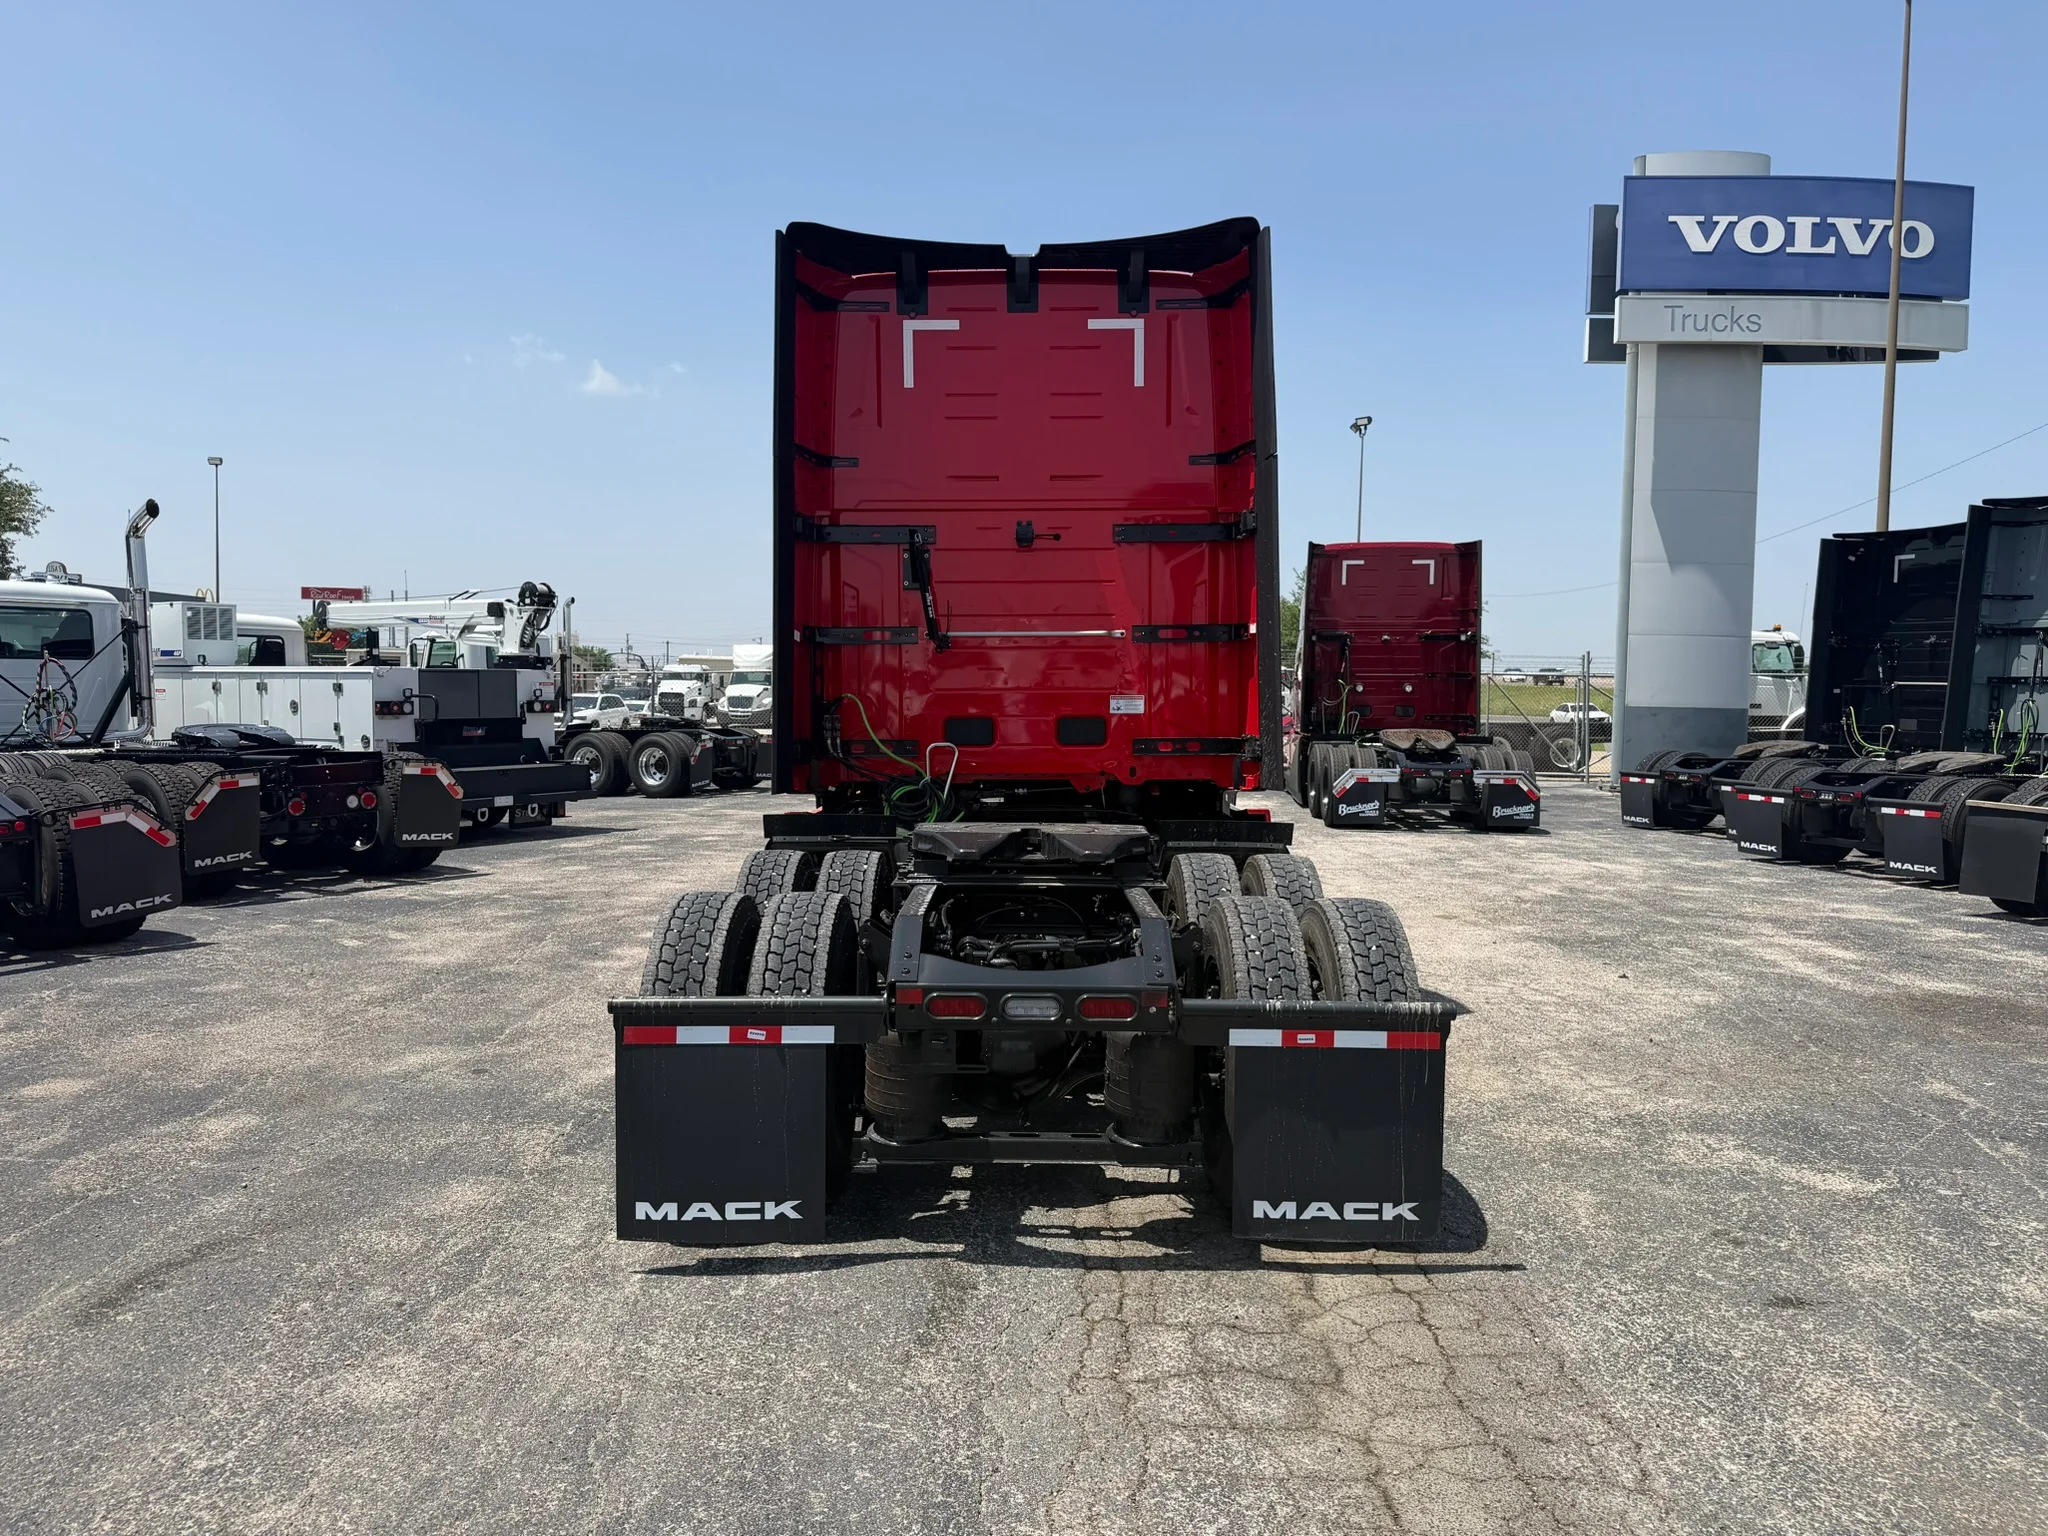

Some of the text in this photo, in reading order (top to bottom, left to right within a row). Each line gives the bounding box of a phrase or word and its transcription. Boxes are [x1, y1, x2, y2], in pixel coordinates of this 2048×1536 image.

[1668, 214, 1935, 259] VOLVO
[1664, 305, 1762, 333] Trucks
[1623, 815, 1650, 824] MACK
[402, 832, 454, 841] MACK
[1740, 841, 1778, 853] MACK
[194, 851, 253, 868] MACK
[1889, 861, 1938, 874] MACK
[91, 893, 173, 919] MACK
[635, 1200, 803, 1221] MACK
[1253, 1200, 1420, 1221] MACK
